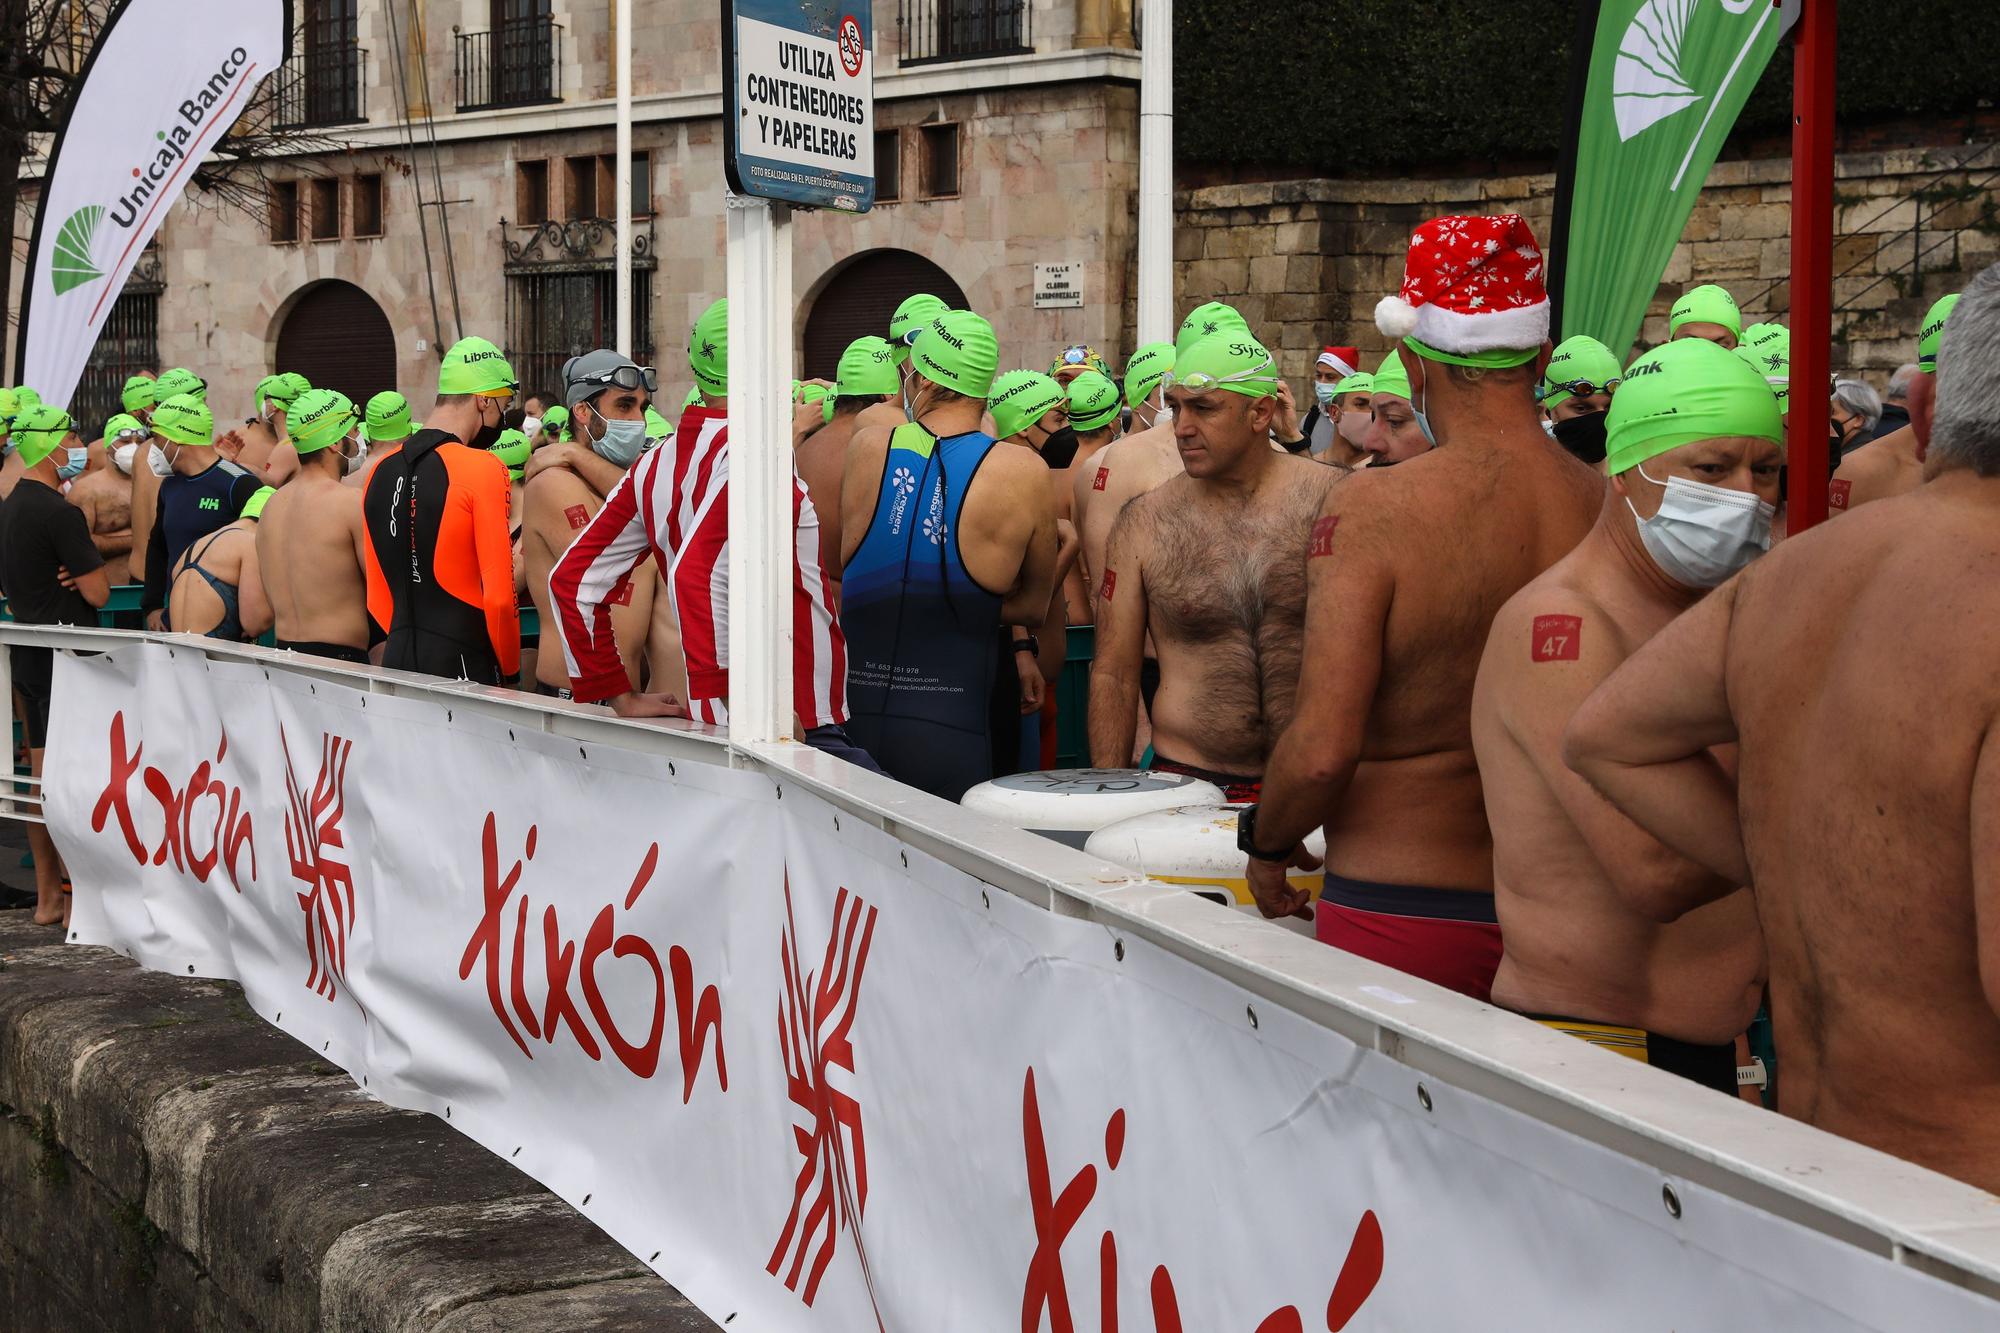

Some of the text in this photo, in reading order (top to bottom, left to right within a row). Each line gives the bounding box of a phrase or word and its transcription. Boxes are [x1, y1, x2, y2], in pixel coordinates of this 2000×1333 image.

[779, 41, 836, 81] UTILIZA
[747, 73, 864, 125] CONTENEDORES
[110, 47, 247, 228] Unicaja Banco
[758, 114, 857, 161] Y PAPELERAS
[751, 166, 763, 176] FOTO
[764, 168, 791, 181] REALIZADA
[791, 173, 798, 183] EN
[798, 174, 805, 183] EL
[805, 175, 823, 186] PUERTO
[822, 178, 846, 191] DEPORTIVO
[846, 182, 852, 192] DE
[921, 354, 959, 380] Mosconi
[1137, 371, 1165, 388] Mosco
[989, 379, 1039, 409] Liberbank
[1025, 395, 1060, 415] Mosconi
[299, 396, 340, 424] Liberbank
[489, 439, 522, 451] erbank
[199, 497, 220, 511] HH
[390, 476, 404, 537] orca
[892, 496, 908, 535] reguera
[1541, 635, 1568, 657] 47
